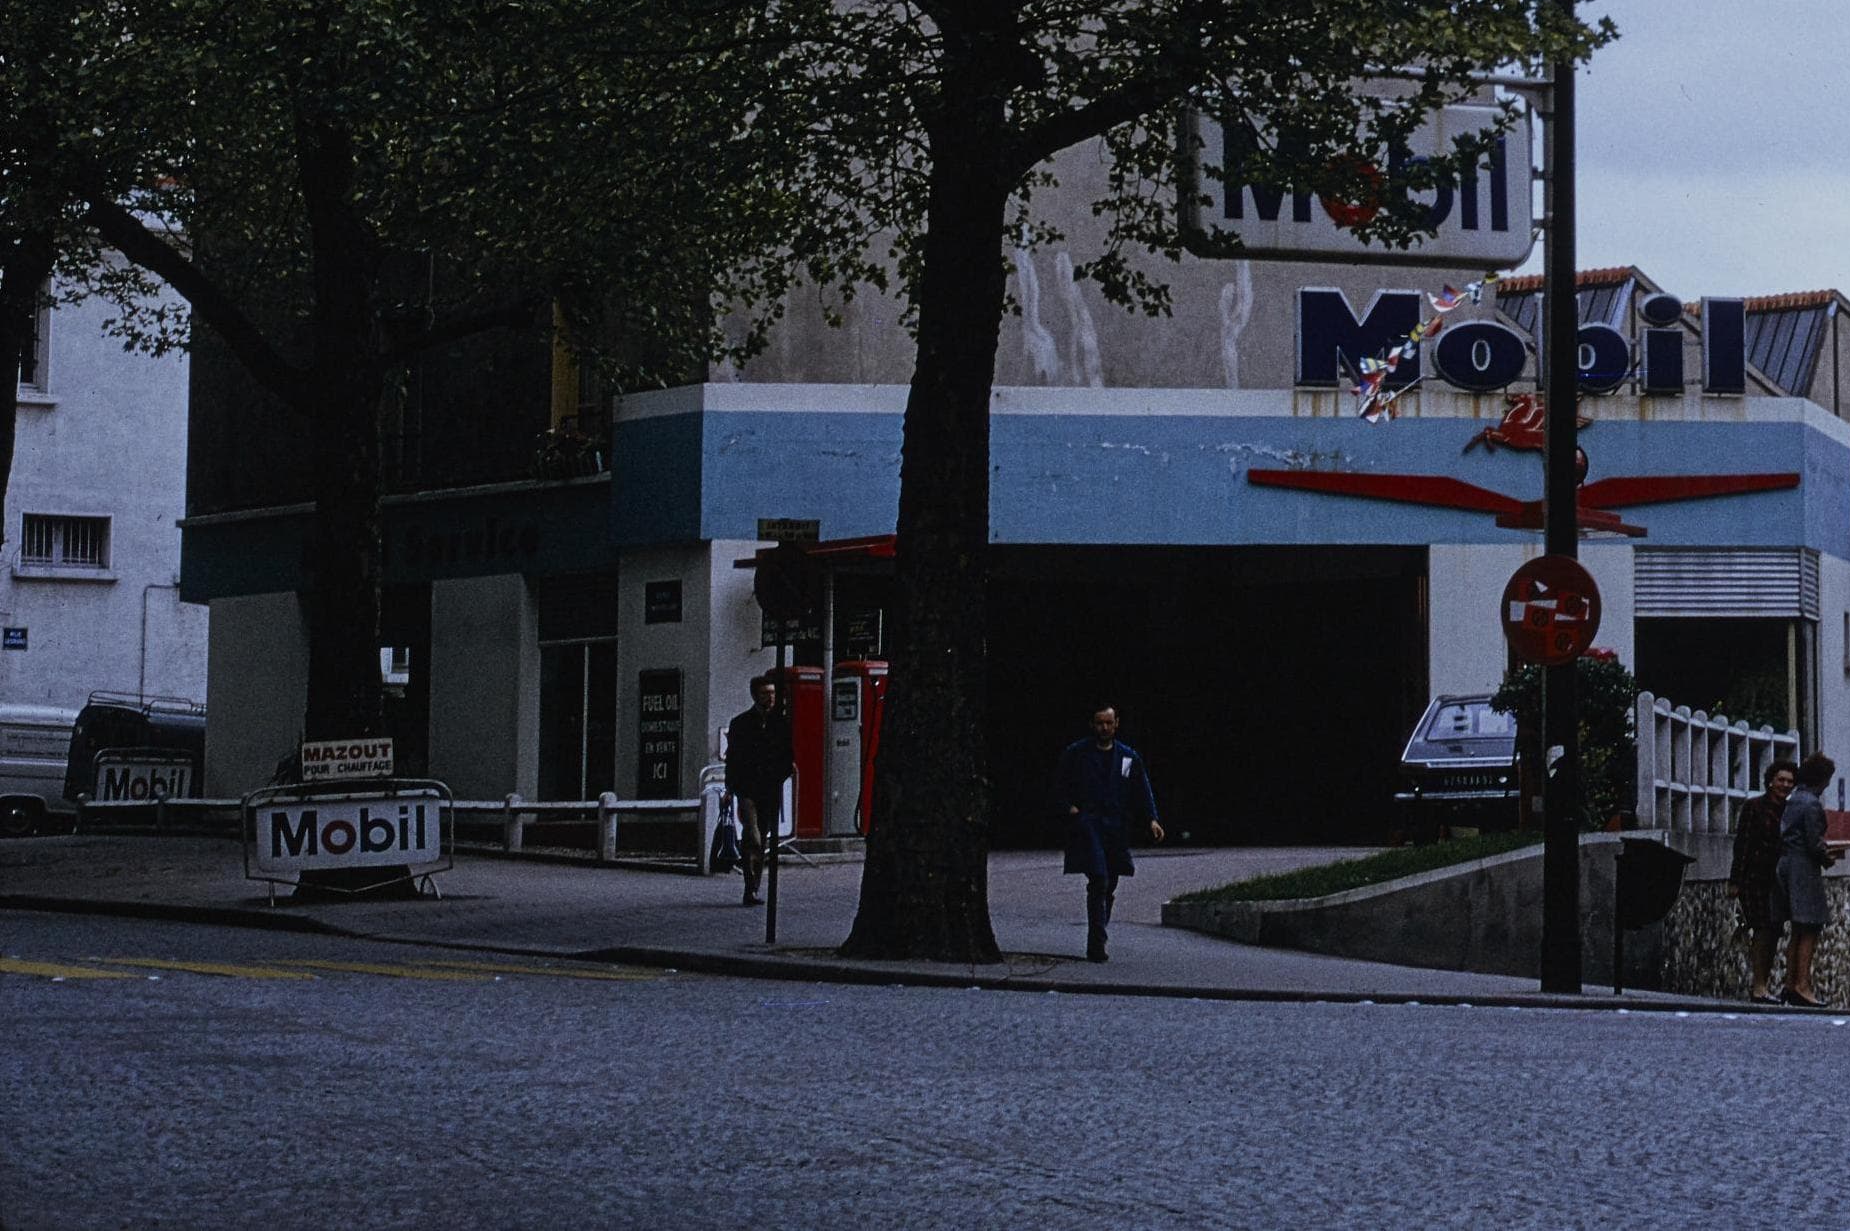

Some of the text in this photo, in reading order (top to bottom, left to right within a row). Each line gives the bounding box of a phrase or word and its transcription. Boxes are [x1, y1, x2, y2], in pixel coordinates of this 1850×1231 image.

[642, 693, 679, 712] FUEL OIL
[303, 744, 391, 762] MAZOUT
[303, 760, 392, 775] POUR CHAUFFAGE
[652, 761, 668, 780] ICI
[103, 767, 185, 801] Mobil
[271, 804, 426, 858] Mobil
